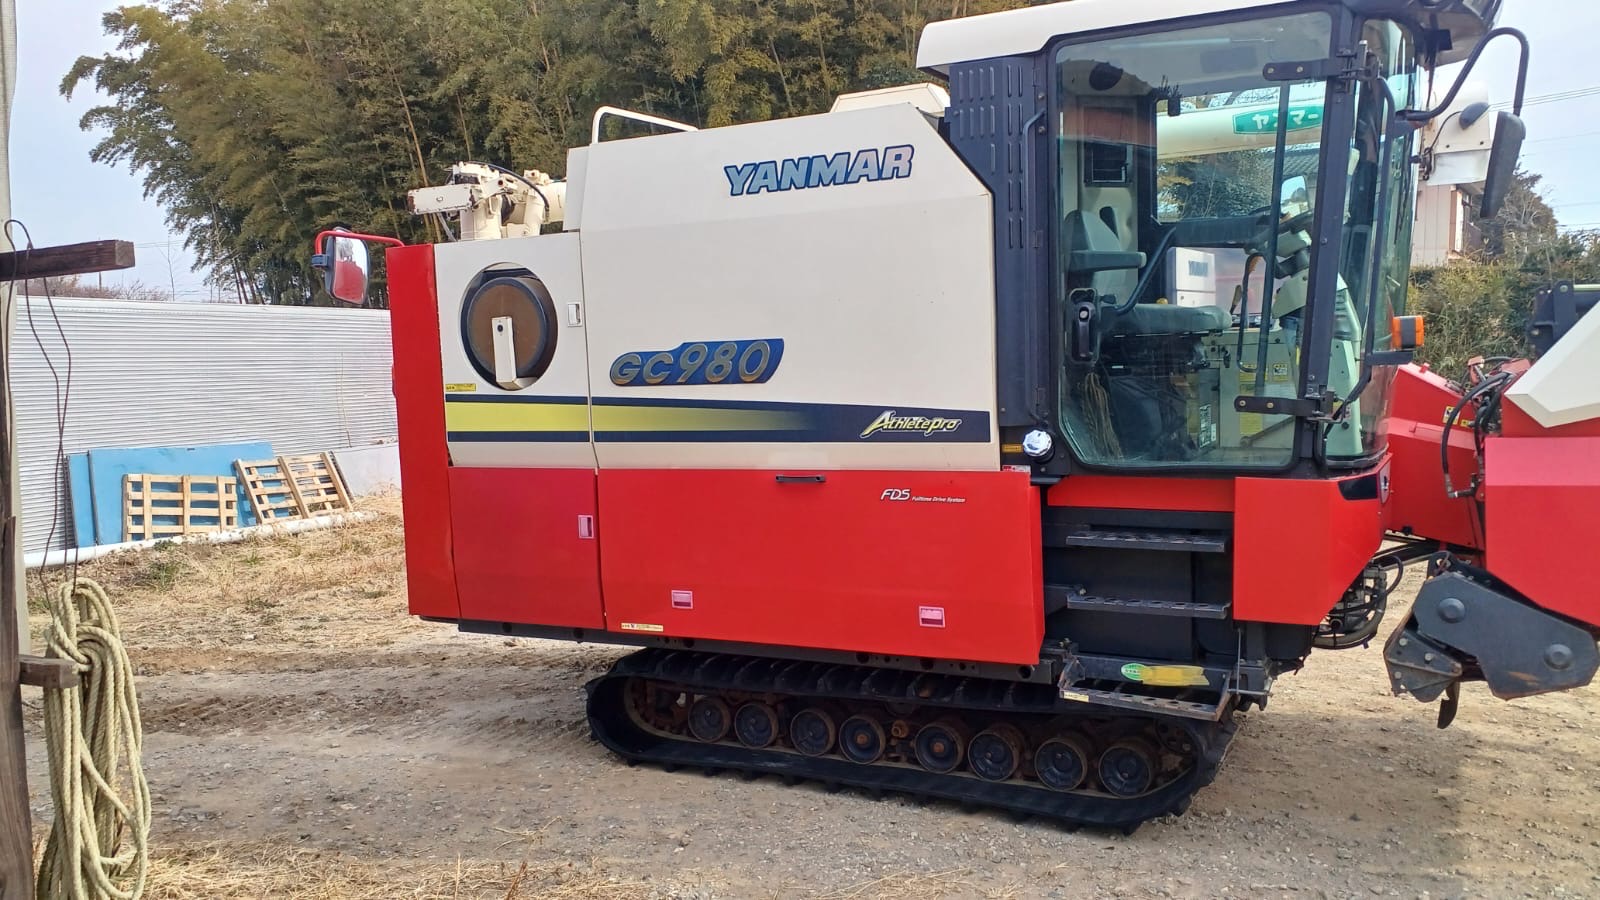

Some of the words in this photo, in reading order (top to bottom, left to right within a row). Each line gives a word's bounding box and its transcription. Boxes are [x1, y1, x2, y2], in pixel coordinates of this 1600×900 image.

[724, 144, 915, 196] YANMAR
[610, 341, 771, 385] GC980
[880, 488, 911, 502] FDS
